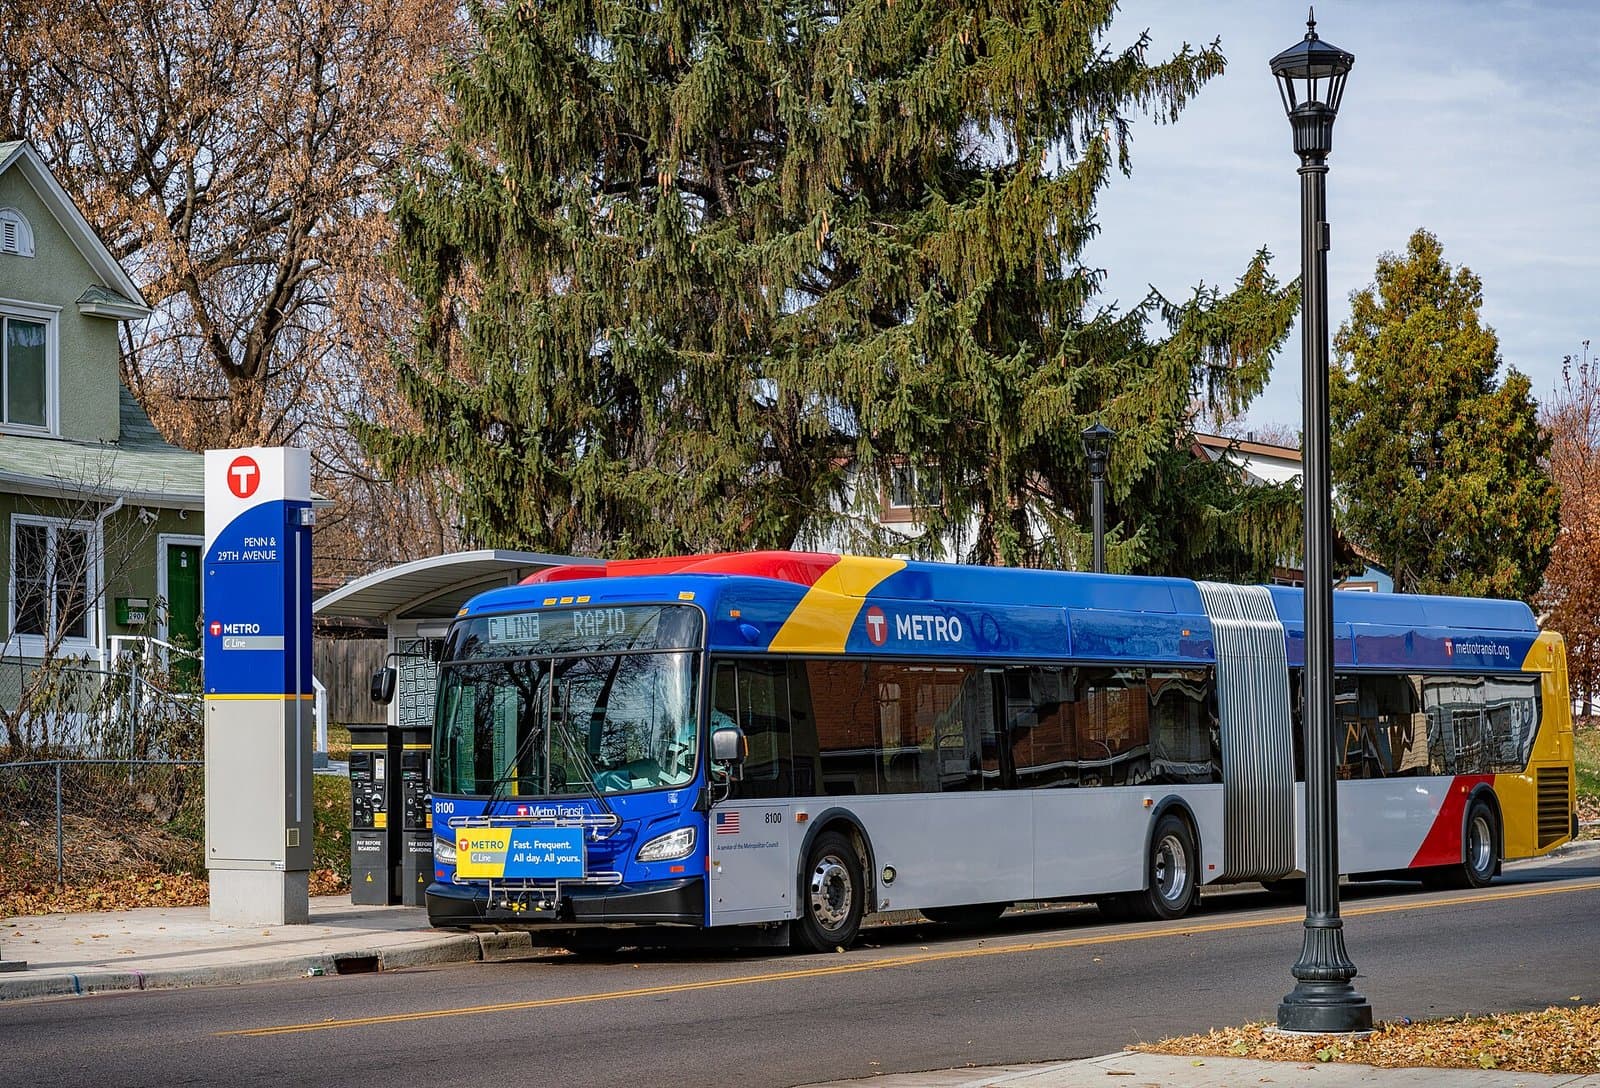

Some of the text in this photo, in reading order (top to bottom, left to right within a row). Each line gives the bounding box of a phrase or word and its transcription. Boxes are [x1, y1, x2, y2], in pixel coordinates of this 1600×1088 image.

[244, 537, 277, 547] PENN &
[217, 550, 277, 561] 29TH AVENUE
[223, 623, 260, 635] METRO
[490, 608, 626, 641] C LINE RAPID
[895, 614, 963, 642] METRO
[224, 638, 246, 648] C Line
[1455, 641, 1510, 660] metrotransit.org
[435, 802, 454, 814] 8100
[765, 812, 782, 824] 8100
[471, 840, 504, 849] METRO
[513, 840, 572, 852] Fast. Frequent.
[471, 853, 491, 862] C Line
[513, 853, 581, 865] All day. All yours.
